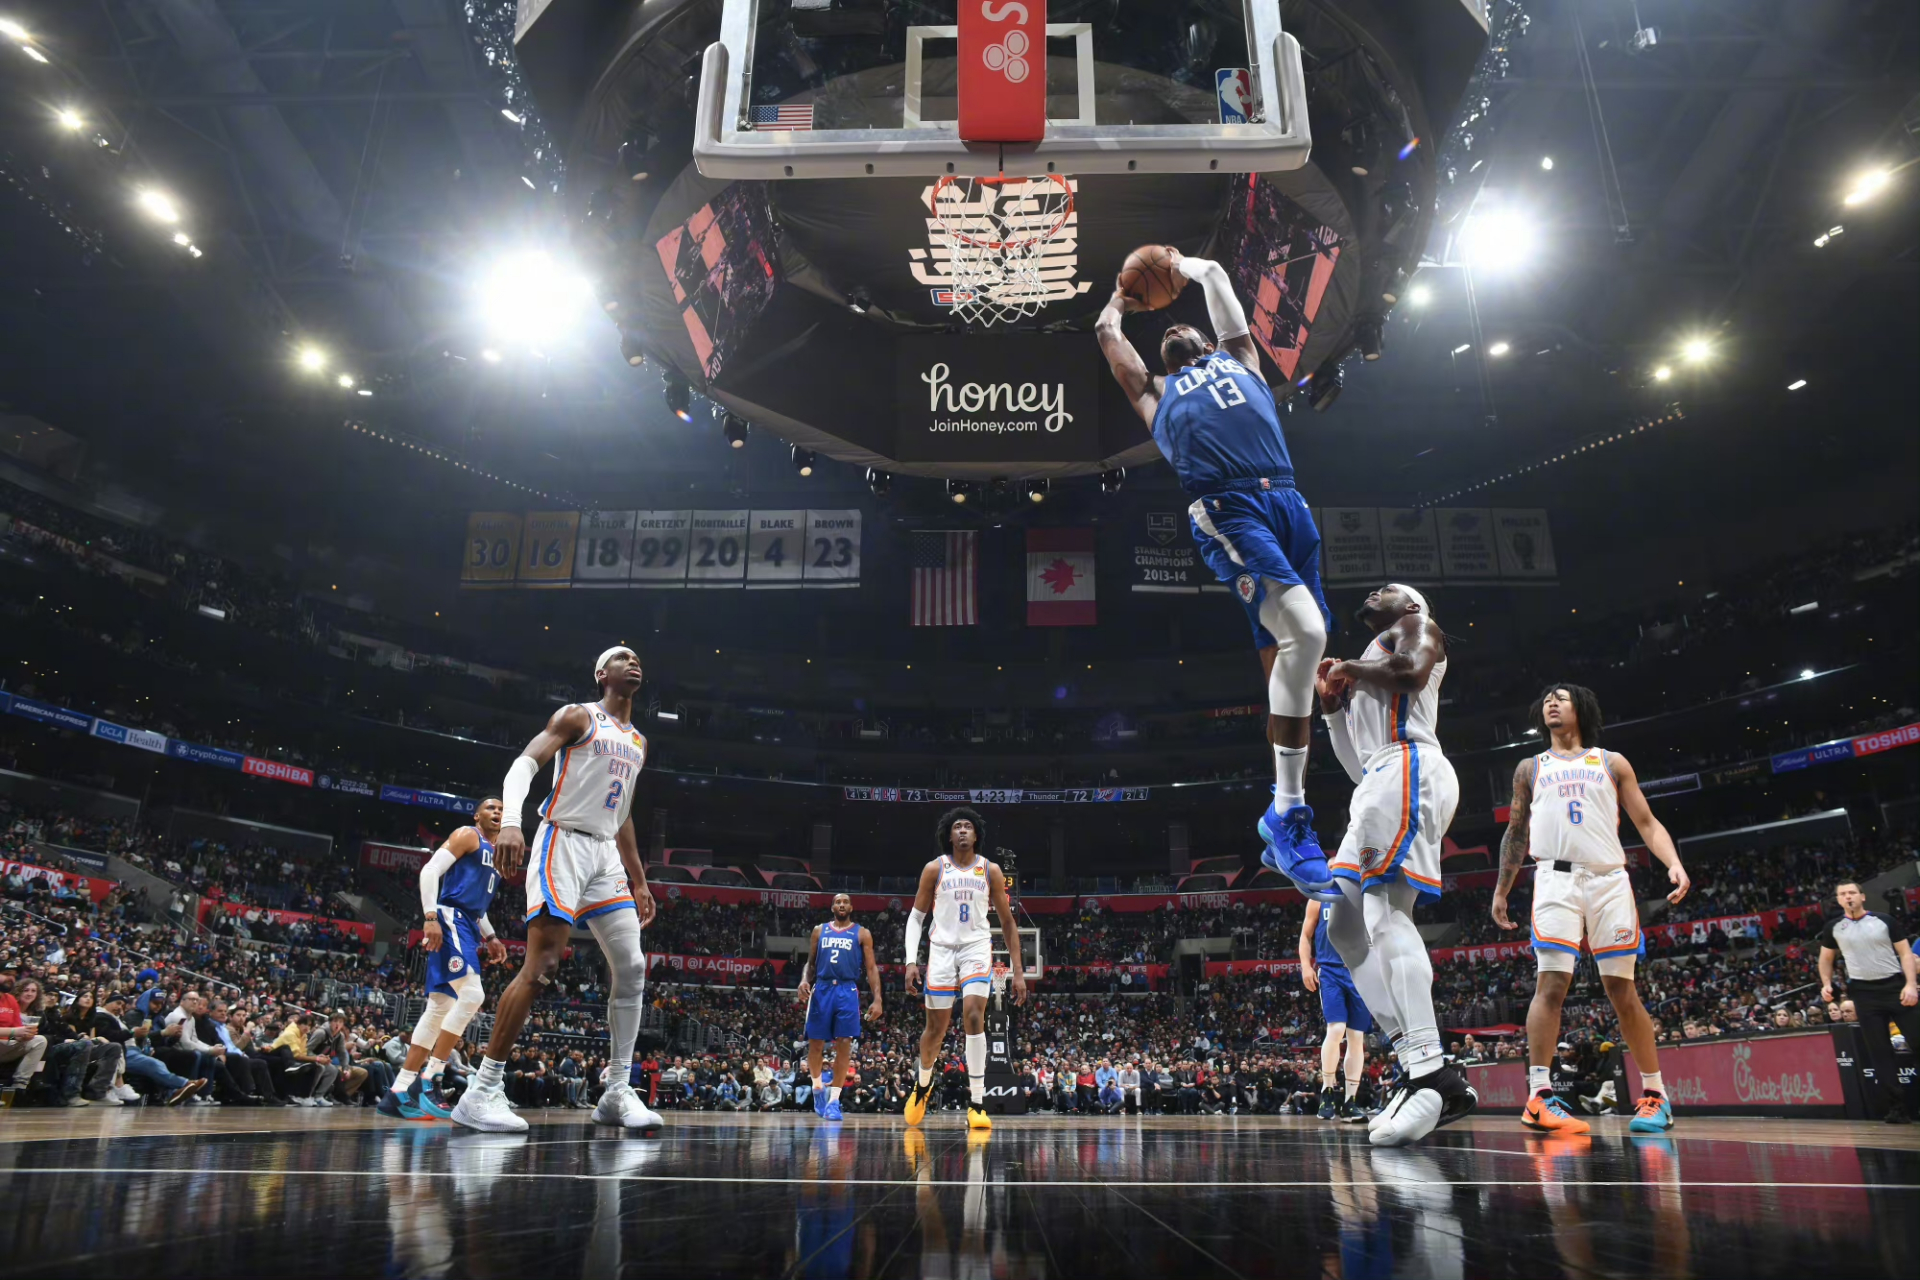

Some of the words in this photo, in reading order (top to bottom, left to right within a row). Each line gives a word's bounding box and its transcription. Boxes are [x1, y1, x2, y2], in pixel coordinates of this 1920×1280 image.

[1225, 115, 1242, 124] NBA
[1174, 357, 1249, 396] CLIPPERS
[920, 362, 1074, 432] honey
[1207, 377, 1247, 410] 13
[929, 418, 1038, 434] JoinHoney.com
[640, 519, 687, 529] GRETZKY
[694, 519, 746, 528] ROBITAILLE
[760, 519, 794, 529] BLAKE
[814, 519, 854, 529] BROWN
[1149, 515, 1174, 527] LA
[470, 538, 511, 568] 30
[530, 538, 564, 568] 16
[587, 538, 620, 567] 18
[640, 536, 683, 567] 99
[695, 536, 740, 567] 20
[764, 536, 784, 567] 4
[812, 536, 852, 567] 23
[1134, 546, 1172, 557] STANLEY
[1174, 548, 1194, 557] CUP
[1135, 555, 1195, 567] CHAMPIONS
[1143, 568, 1188, 582] 2013-14
[14, 702, 54, 719] AMERICAN
[54, 713, 88, 728] EXPRESS
[100, 725, 123, 739] UCLA
[128, 732, 163, 750] Health
[1856, 726, 1920, 752] TOSHIB
[189, 748, 236, 764] crypto.com
[1814, 746, 1850, 760] ULTRA
[247, 759, 310, 784] TOSHIBA
[608, 758, 633, 780] CITY
[339, 778, 369, 789] 2022-23
[1539, 769, 1605, 788] OKLAHOMA
[341, 784, 374, 796] CLIPPERS
[603, 778, 624, 812] 2
[862, 791, 868, 799] 3
[906, 790, 921, 801] 73
[934, 792, 965, 801] Clippers
[975, 790, 1006, 803] 4:23
[1072, 790, 1088, 801] 72
[1126, 792, 1132, 800] 2
[1139, 792, 1145, 800] 4
[1558, 782, 1586, 797] CITY
[417, 794, 444, 806] ULTRA
[1568, 800, 1584, 826] 6
[381, 849, 423, 870] CLIPPERS
[487, 872, 496, 894] 0
[941, 878, 986, 892] OKLAHOMA
[954, 890, 974, 901] CITY
[959, 903, 969, 923] 8
[821, 937, 853, 950] CLIPPERS
[829, 949, 840, 964] 2
[1732, 1055, 1824, 1104] Chick-fil-A
